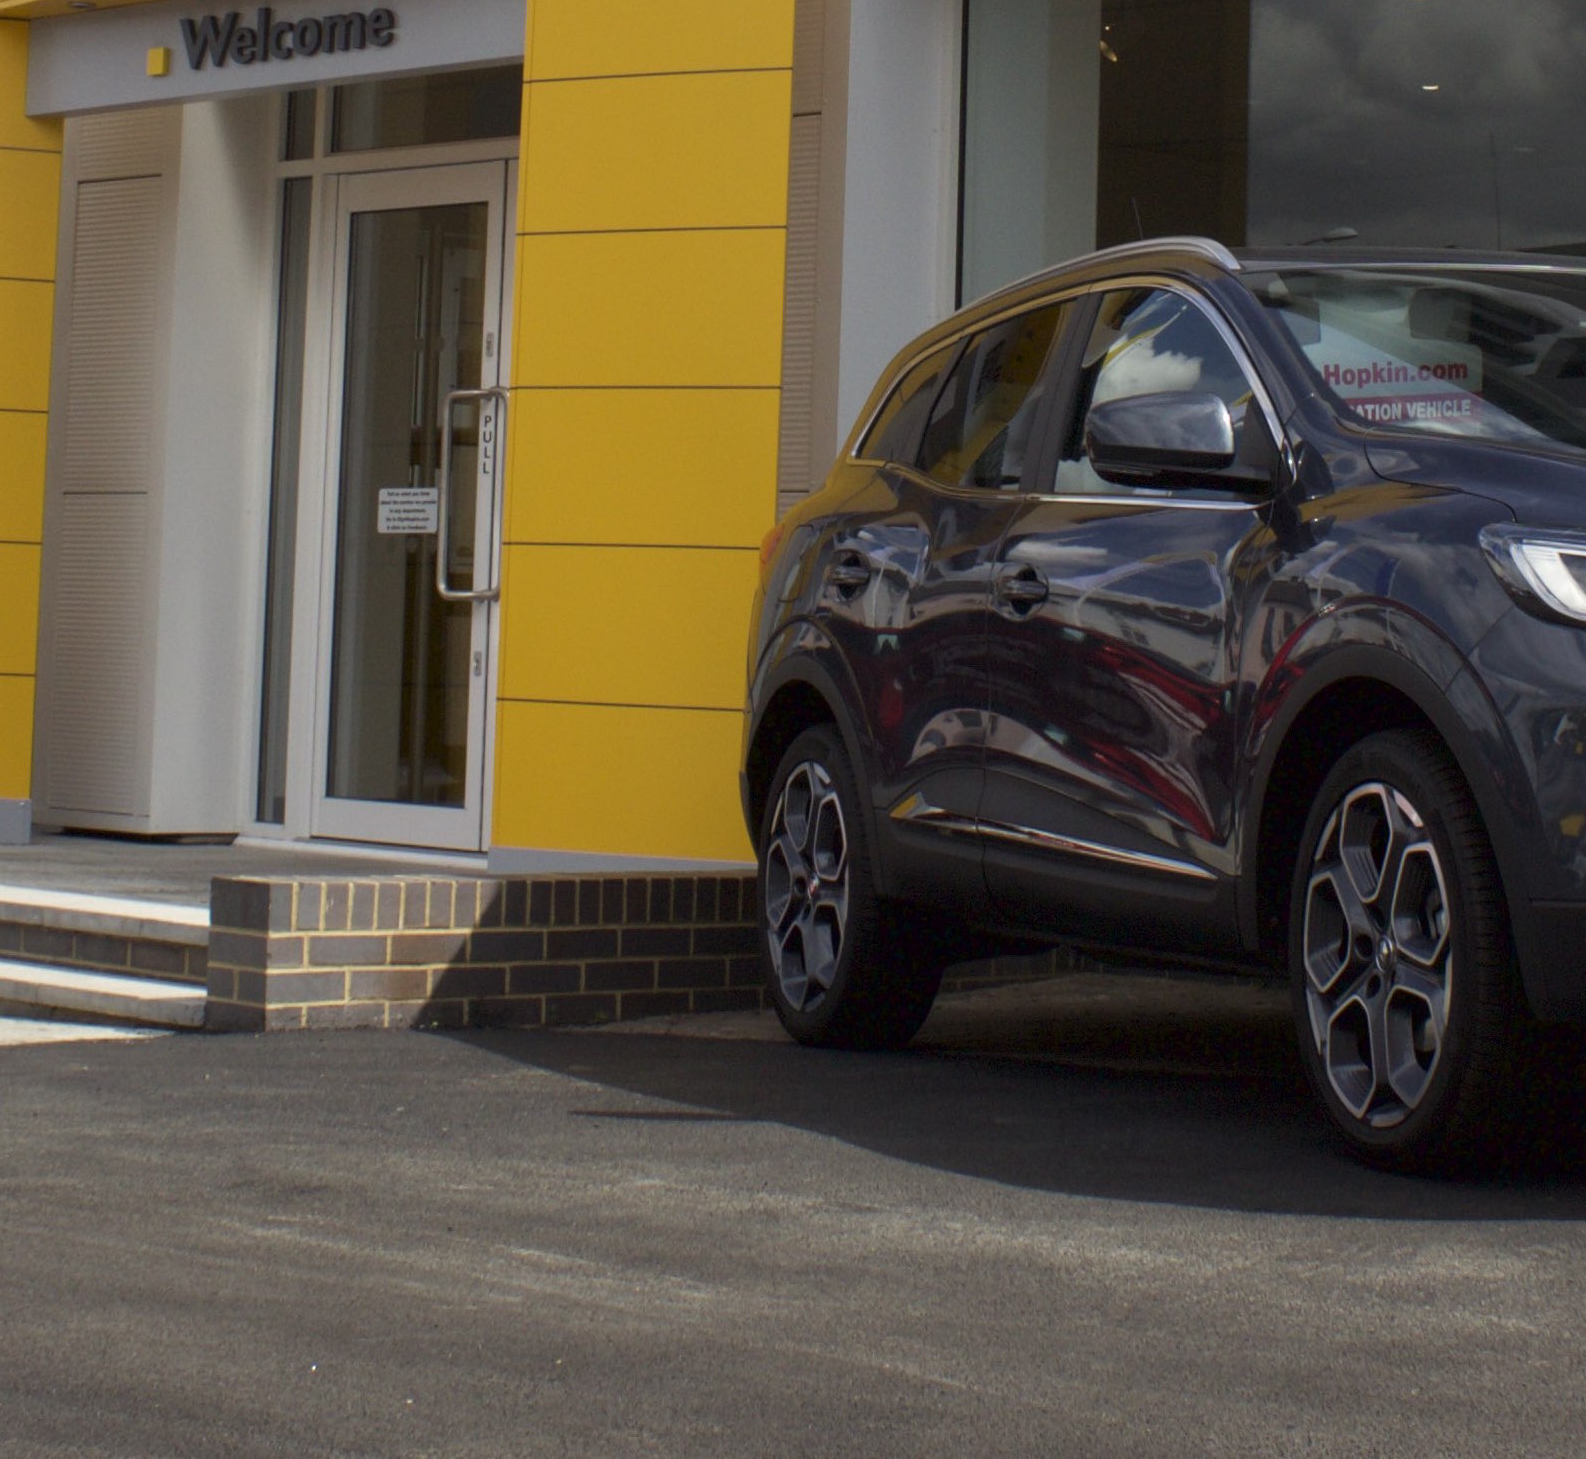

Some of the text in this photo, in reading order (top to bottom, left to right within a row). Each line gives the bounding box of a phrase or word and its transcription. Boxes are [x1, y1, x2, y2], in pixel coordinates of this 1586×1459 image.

[180, 7, 396, 71] Welcome
[1323, 361, 1469, 389] Hopkin.com
[1407, 399, 1471, 418] VEHICLE
[482, 415, 493, 474] PULL
